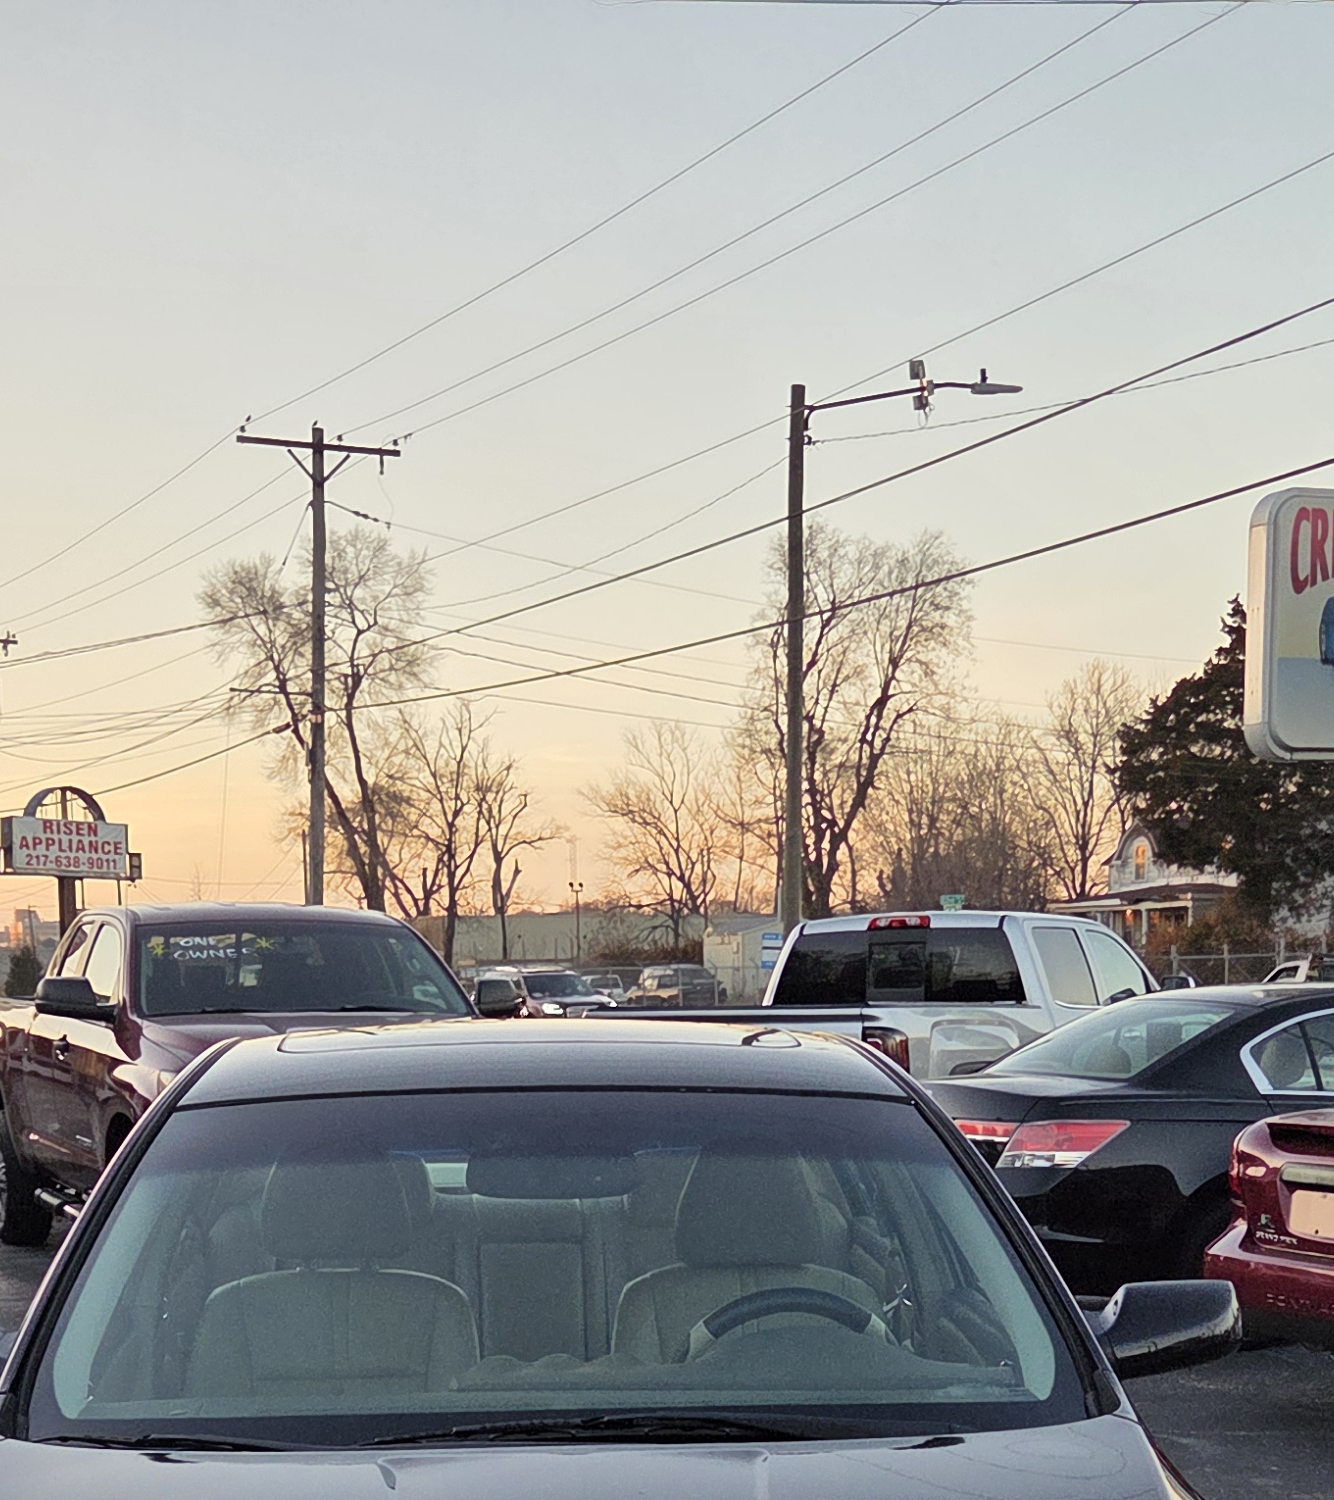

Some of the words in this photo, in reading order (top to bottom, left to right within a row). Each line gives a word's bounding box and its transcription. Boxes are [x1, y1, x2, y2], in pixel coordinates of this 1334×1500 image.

[42, 820, 98, 837] RISEN
[19, 836, 124, 856] APPLIANCE
[25, 853, 117, 870] 217-638-9011
[179, 936, 217, 947] ONE
